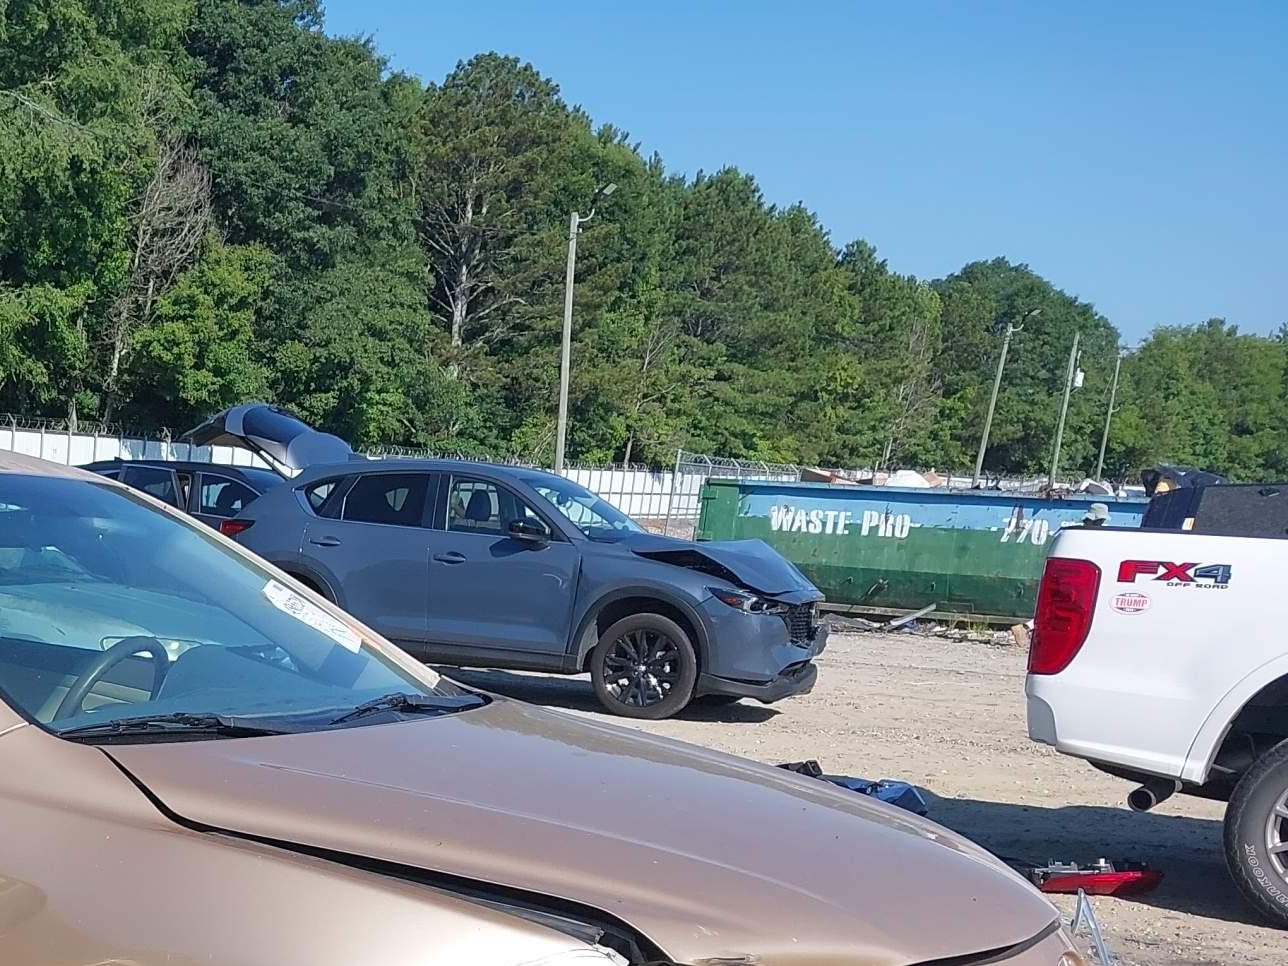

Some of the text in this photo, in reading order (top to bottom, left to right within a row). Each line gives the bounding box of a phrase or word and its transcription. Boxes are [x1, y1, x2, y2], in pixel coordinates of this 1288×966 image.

[770, 504, 911, 539] WASTE PRO
[1116, 559, 1232, 584] FX4
[1115, 597, 1148, 608] TRUMP
